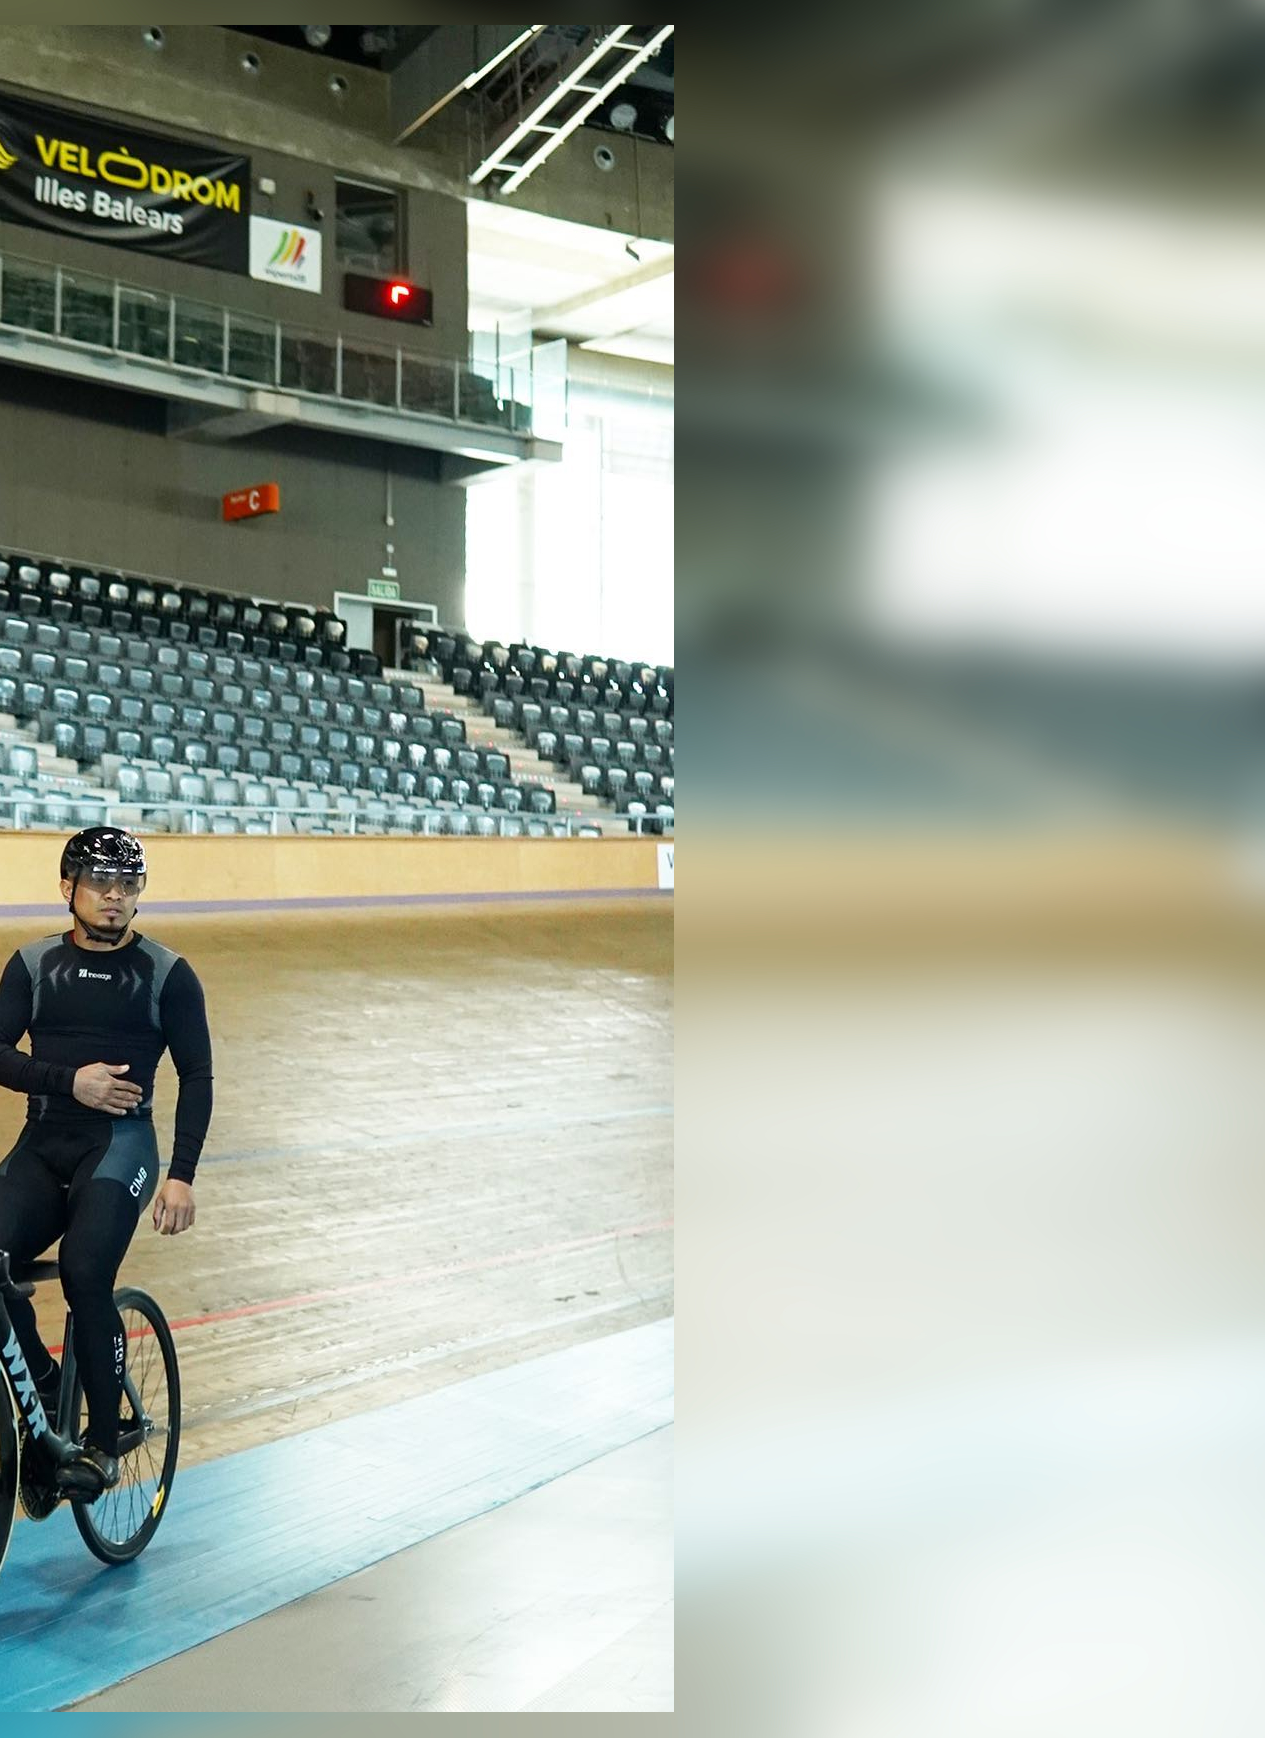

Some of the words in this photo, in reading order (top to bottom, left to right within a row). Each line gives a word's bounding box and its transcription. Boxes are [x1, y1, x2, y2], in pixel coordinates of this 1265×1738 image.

[35, 133, 241, 213] VELÒDROM
[35, 175, 88, 212] Illes
[92, 189, 184, 234] Balears
[249, 490, 260, 511] C
[129, 1166, 148, 1197] CIMB
